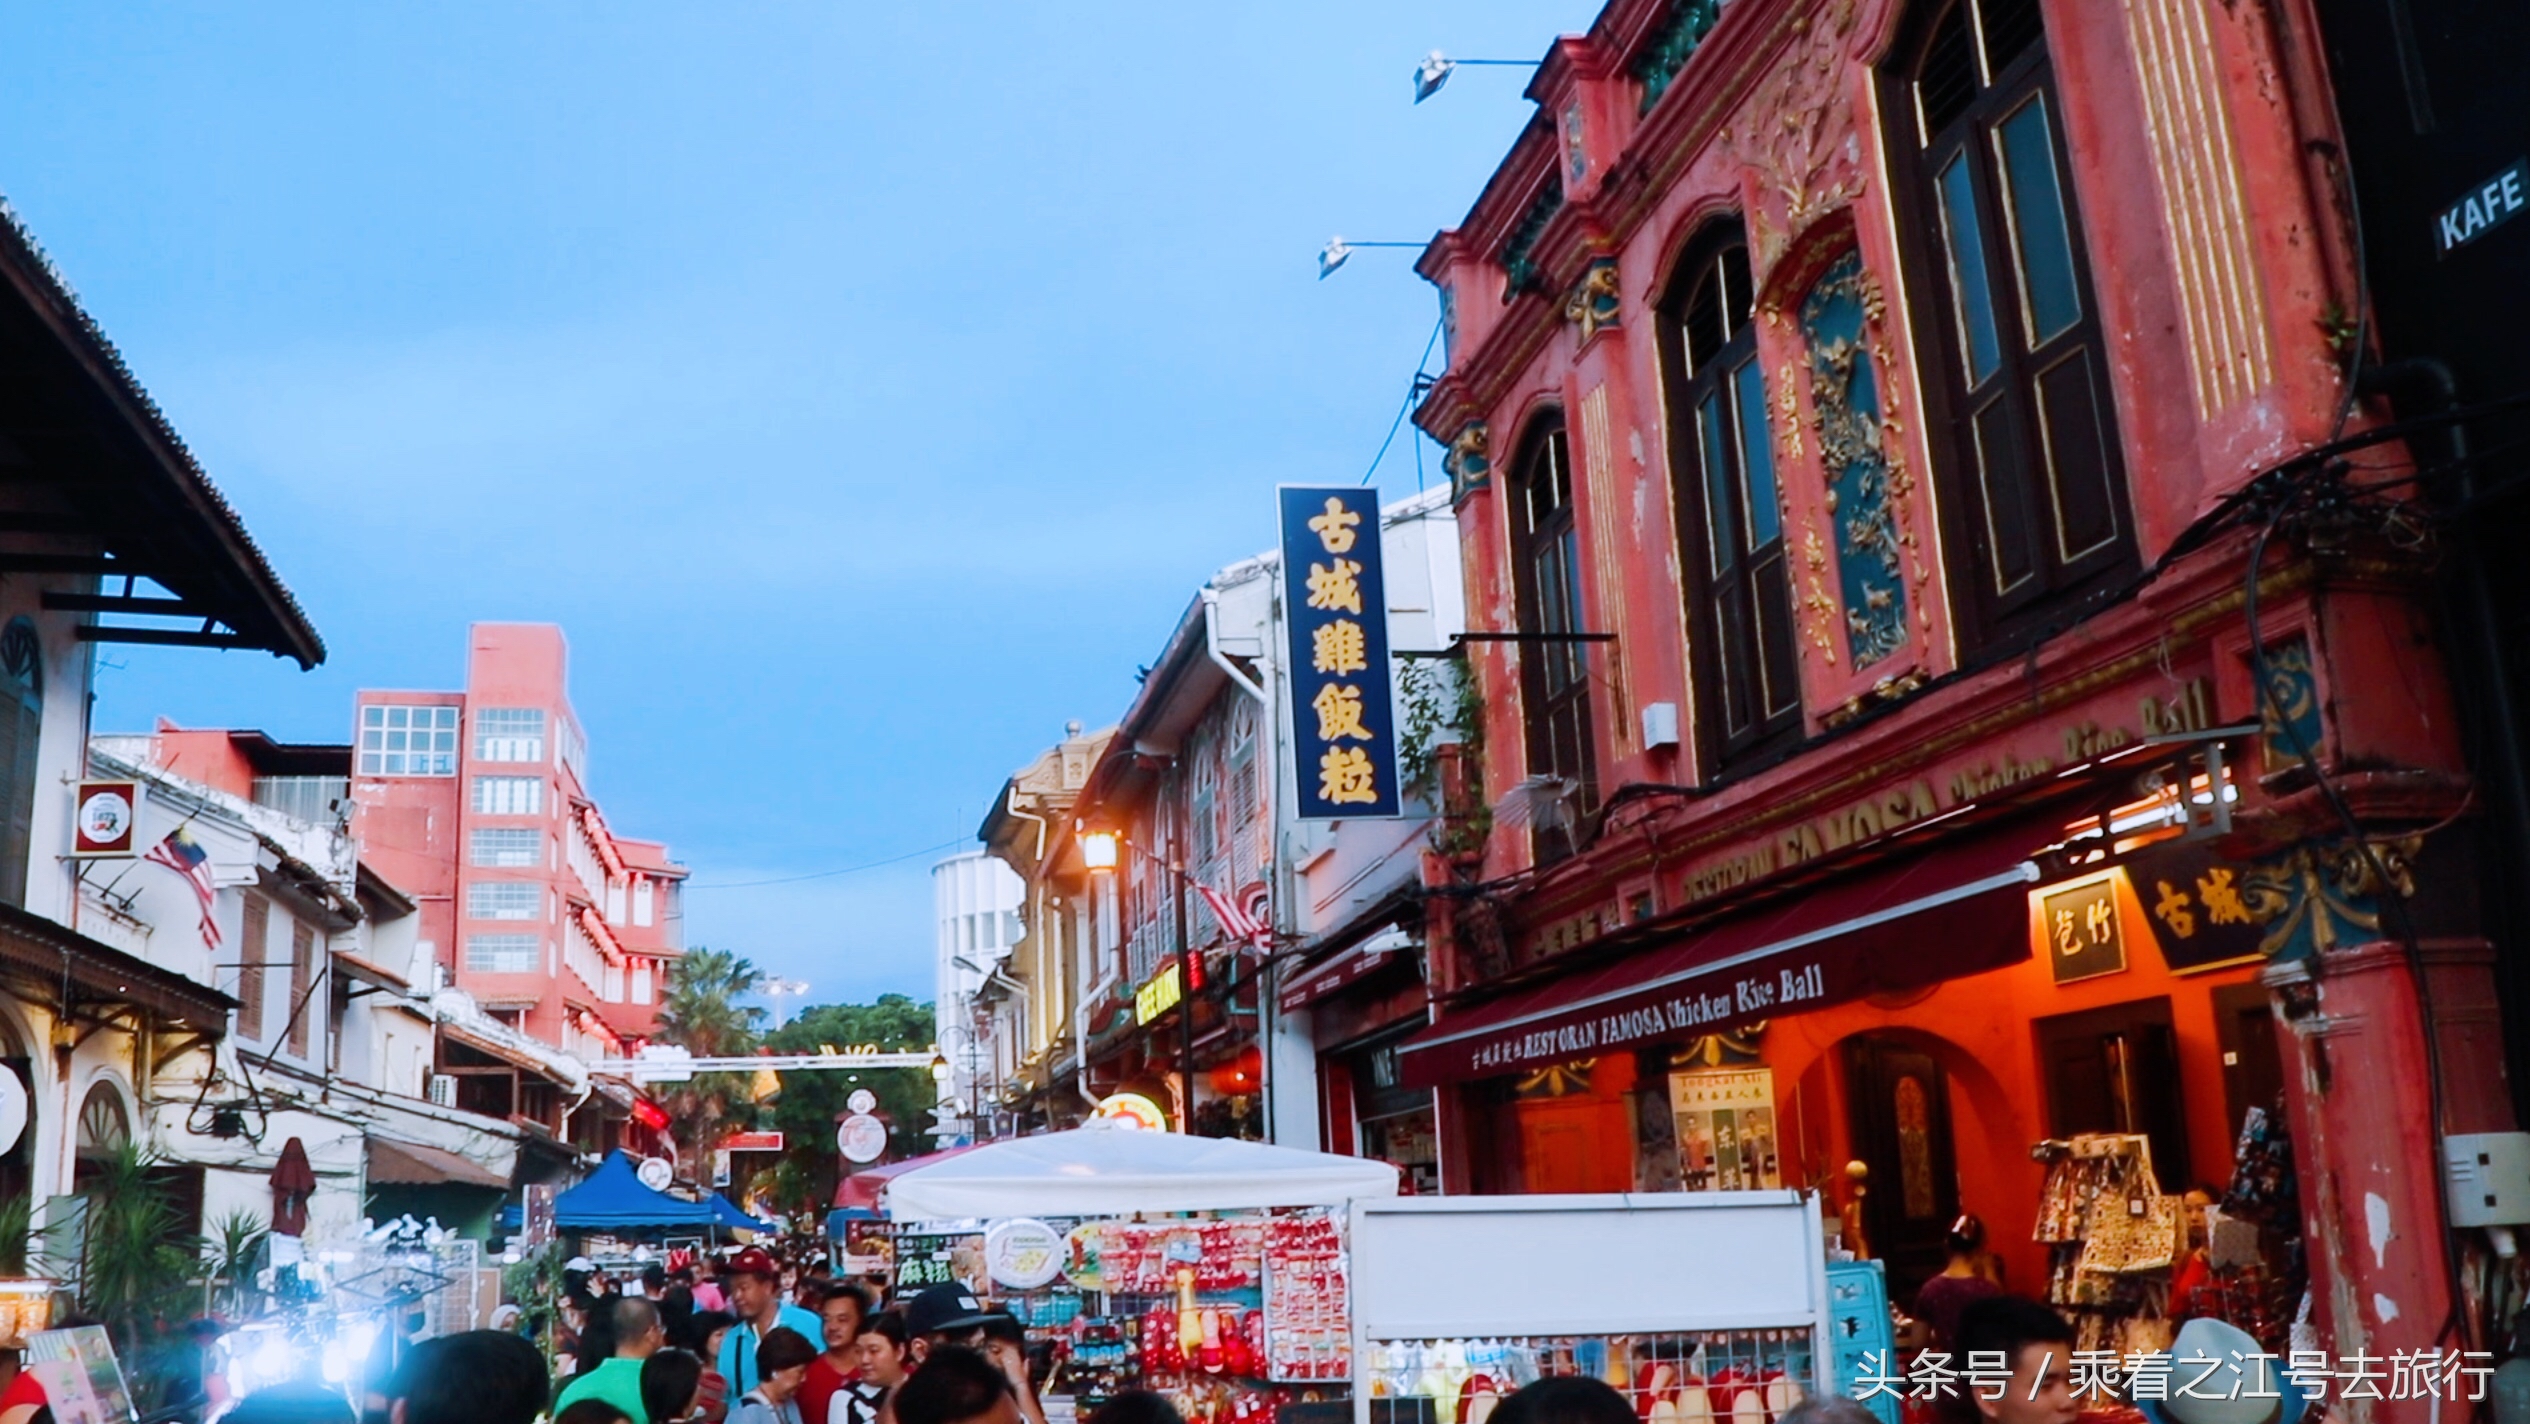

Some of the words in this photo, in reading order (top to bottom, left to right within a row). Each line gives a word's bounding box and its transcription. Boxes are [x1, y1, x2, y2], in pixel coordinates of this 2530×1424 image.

[2440, 170, 2524, 249] KAFE
[1306, 496, 1378, 805] 古城雞飯粒
[1601, 1005, 1666, 1045] FAMOSA
[1666, 992, 1731, 1029] Chicken
[1736, 978, 1775, 1013] Rice
[1780, 963, 1824, 1004] Ball
